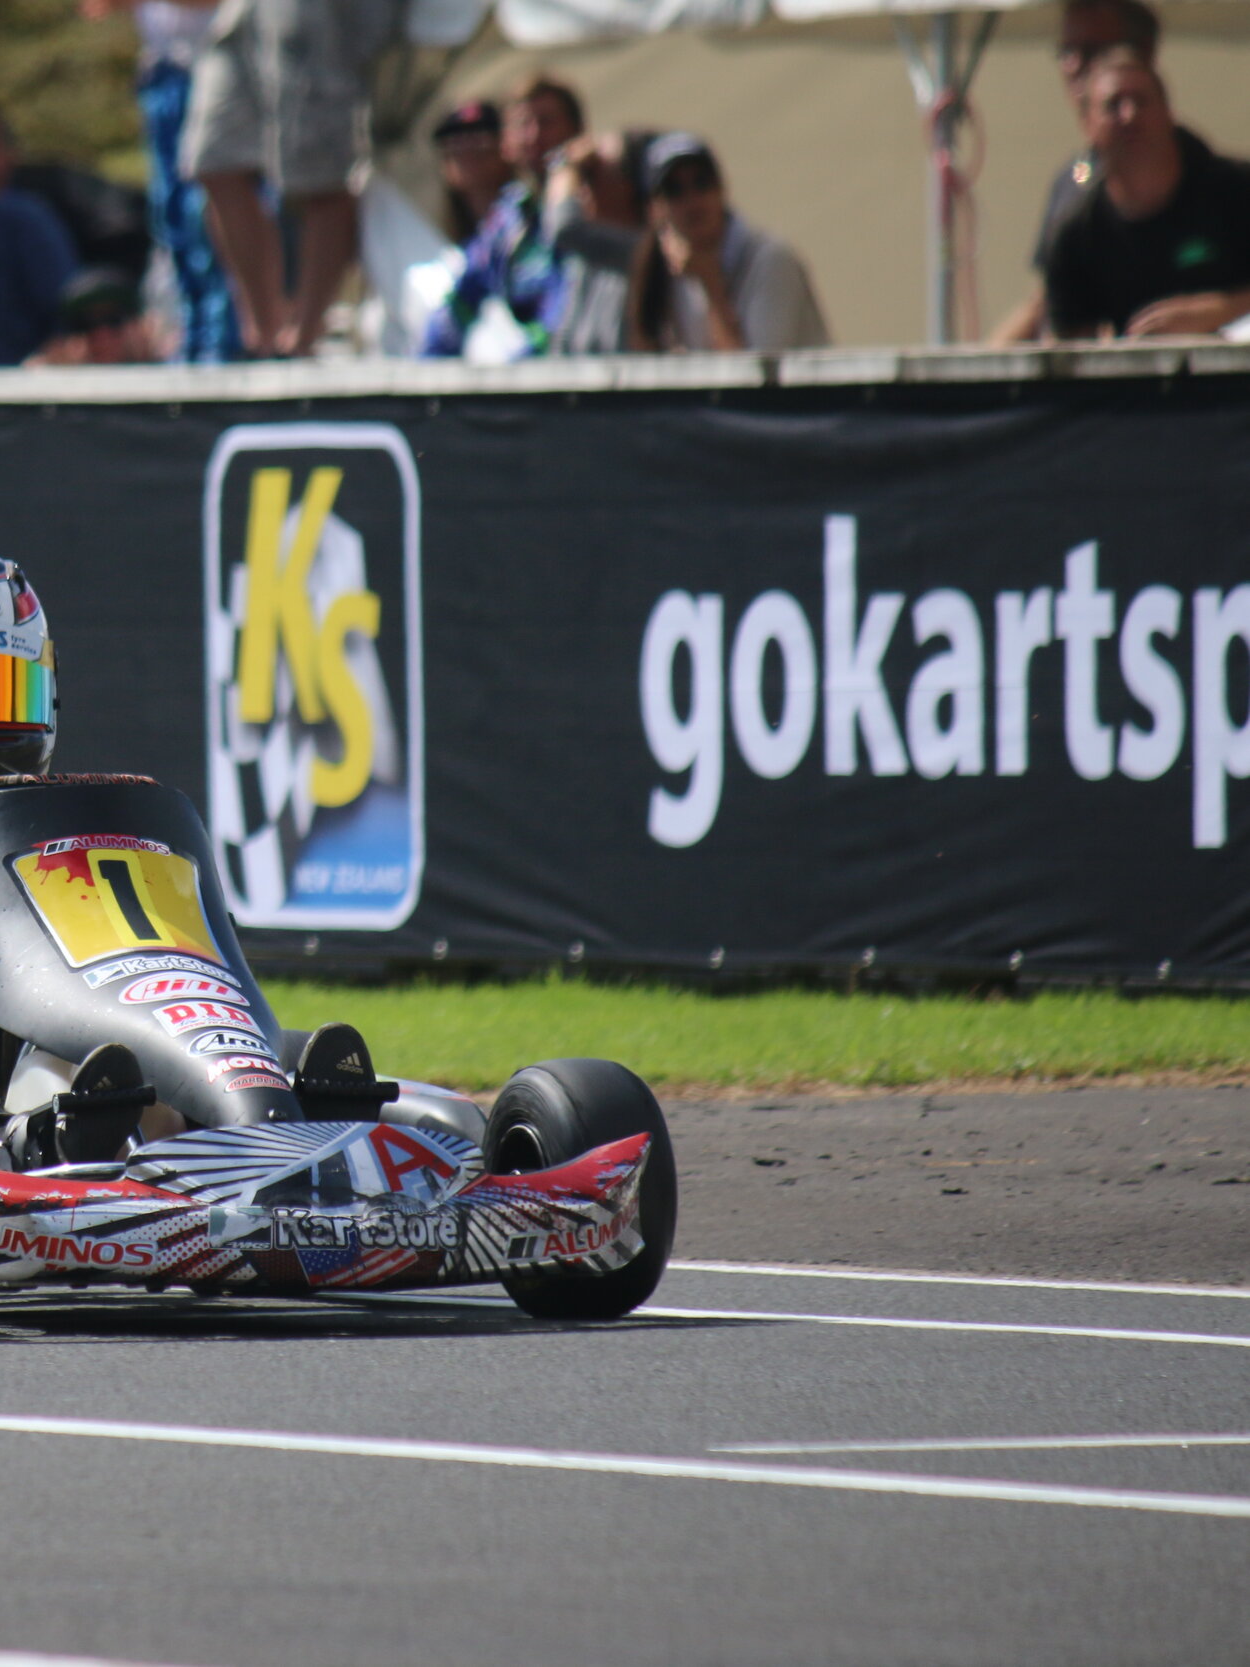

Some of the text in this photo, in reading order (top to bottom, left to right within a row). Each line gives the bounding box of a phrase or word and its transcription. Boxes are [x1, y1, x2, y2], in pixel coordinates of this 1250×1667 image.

[70, 836, 170, 856] ALUMINOS
[97, 859, 162, 940] 1
[207, 1056, 287, 1084] MOTU
[275, 1208, 458, 1250] KartStore
